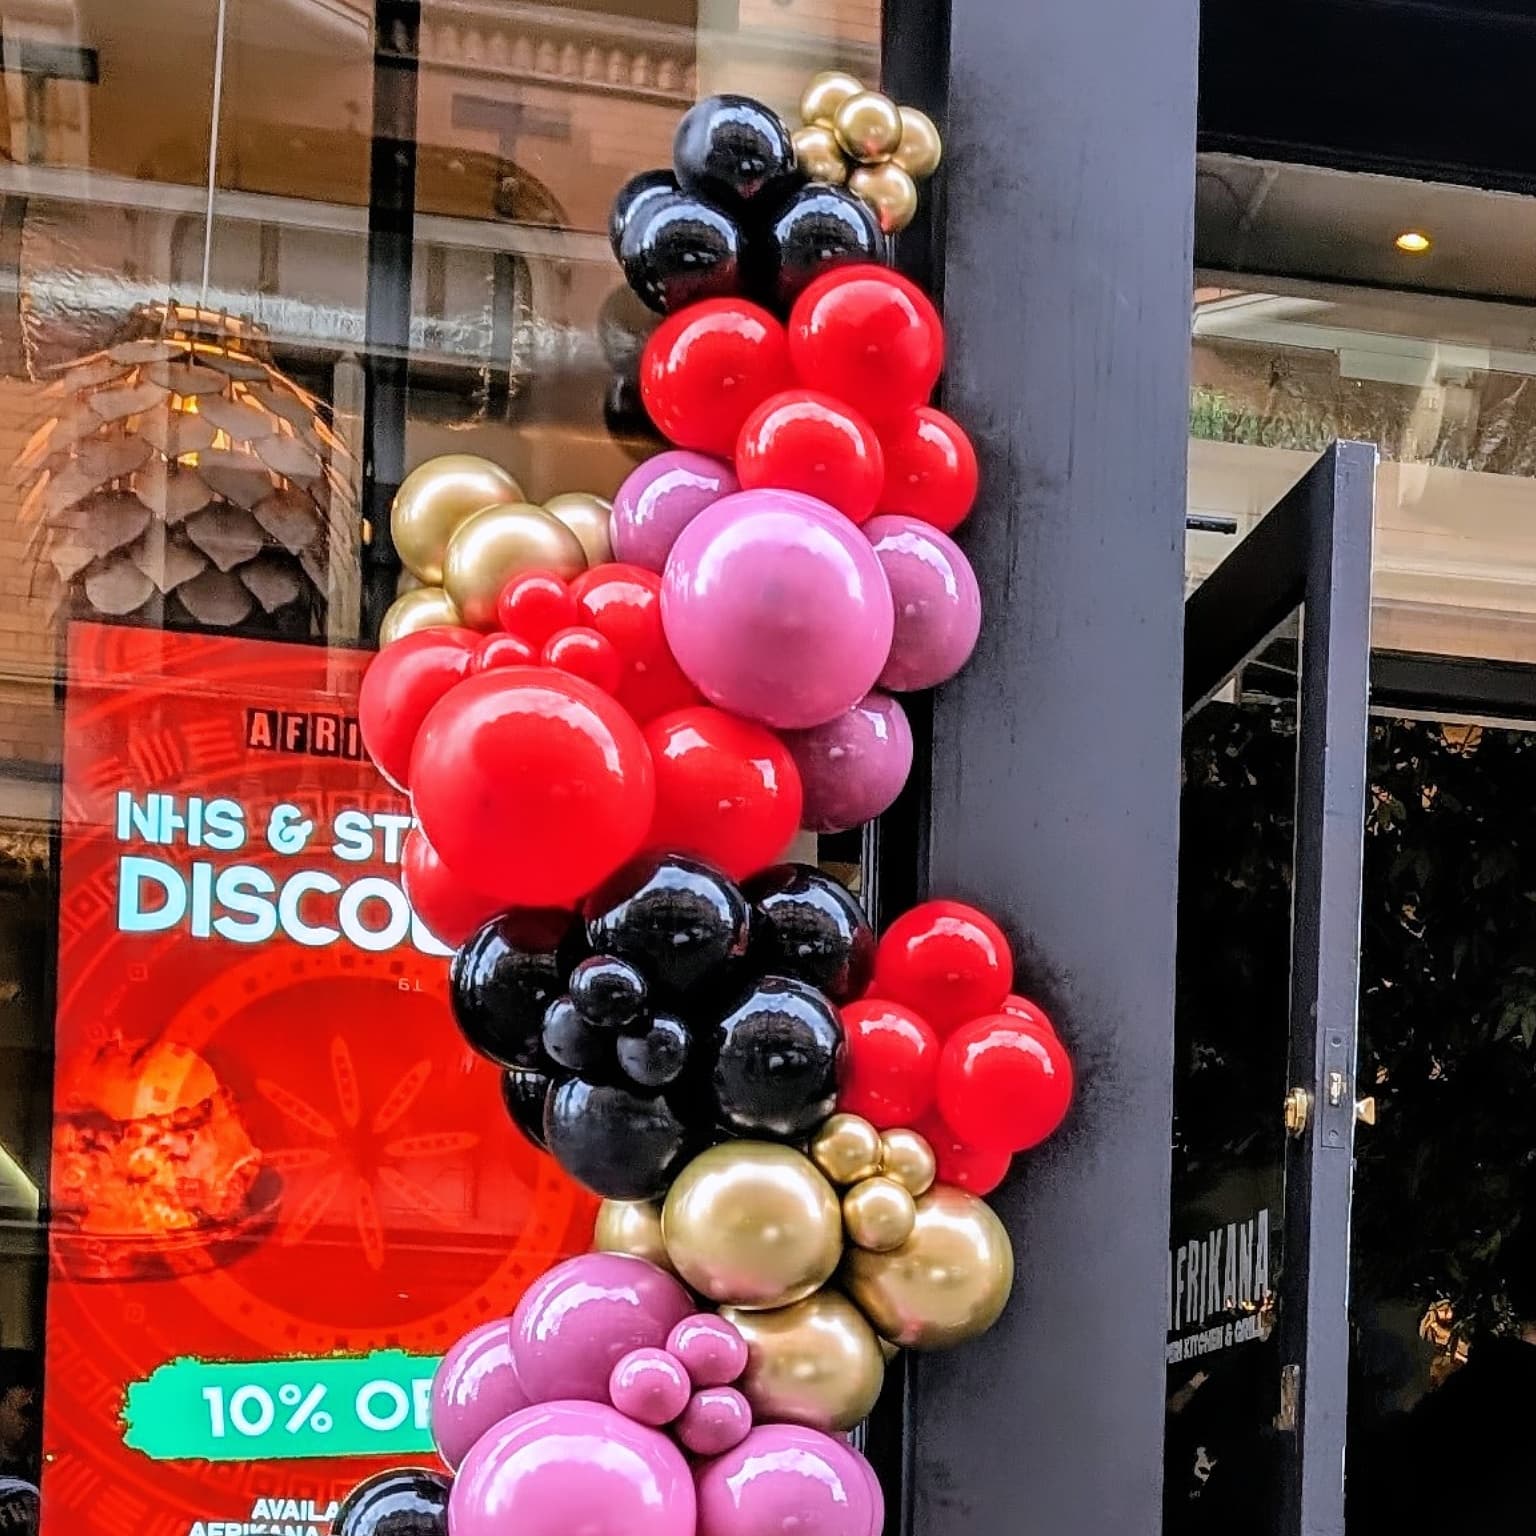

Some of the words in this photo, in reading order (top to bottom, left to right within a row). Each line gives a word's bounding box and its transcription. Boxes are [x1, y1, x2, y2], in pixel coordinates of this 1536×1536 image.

[249, 712, 360, 757] AFRI
[117, 791, 245, 850] NHS
[267, 804, 314, 854] &
[332, 810, 418, 864] ST
[202, 1383, 333, 1438] 10%
[355, 1378, 434, 1432] OF
[251, 1498, 339, 1521] AVAILA
